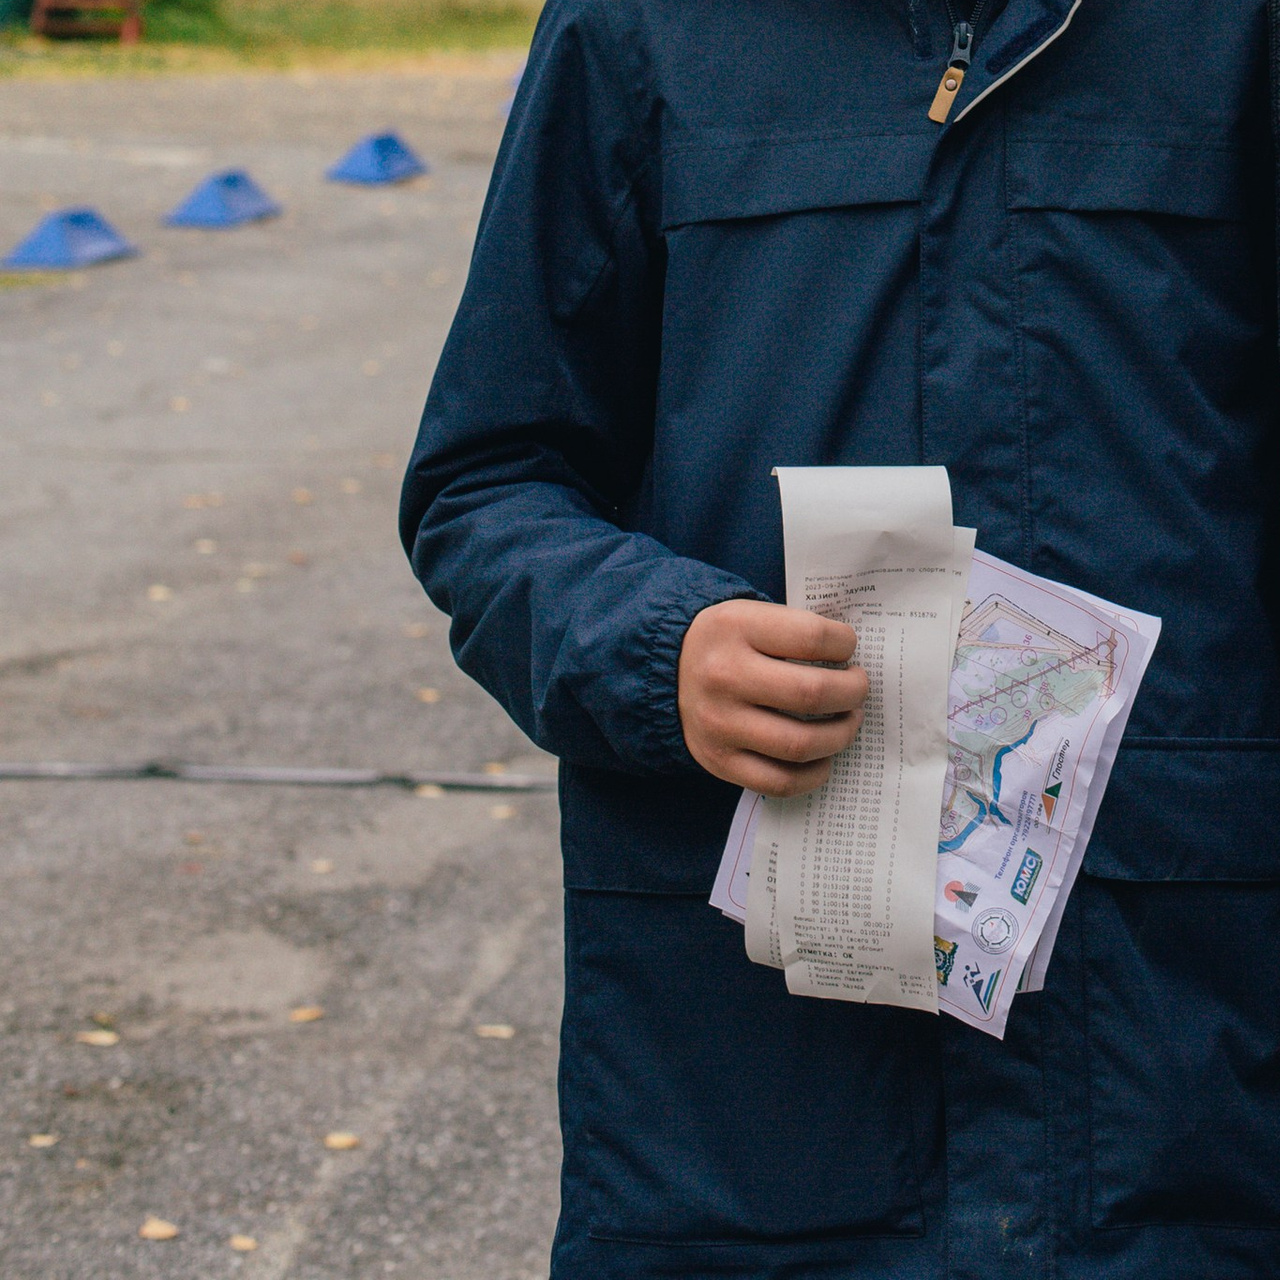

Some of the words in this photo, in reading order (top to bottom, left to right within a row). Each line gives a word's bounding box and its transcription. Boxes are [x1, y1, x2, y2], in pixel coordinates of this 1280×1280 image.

[806, 592, 838, 600] Хазиев
[844, 584, 876, 595] Эдуард
[1052, 738, 1070, 780] Глостер
[1013, 856, 1037, 897] ЮМС
[820, 917, 849, 926] 12:24:23
[860, 929, 890, 937] 01:01:23
[797, 948, 837, 958] Отметка:
